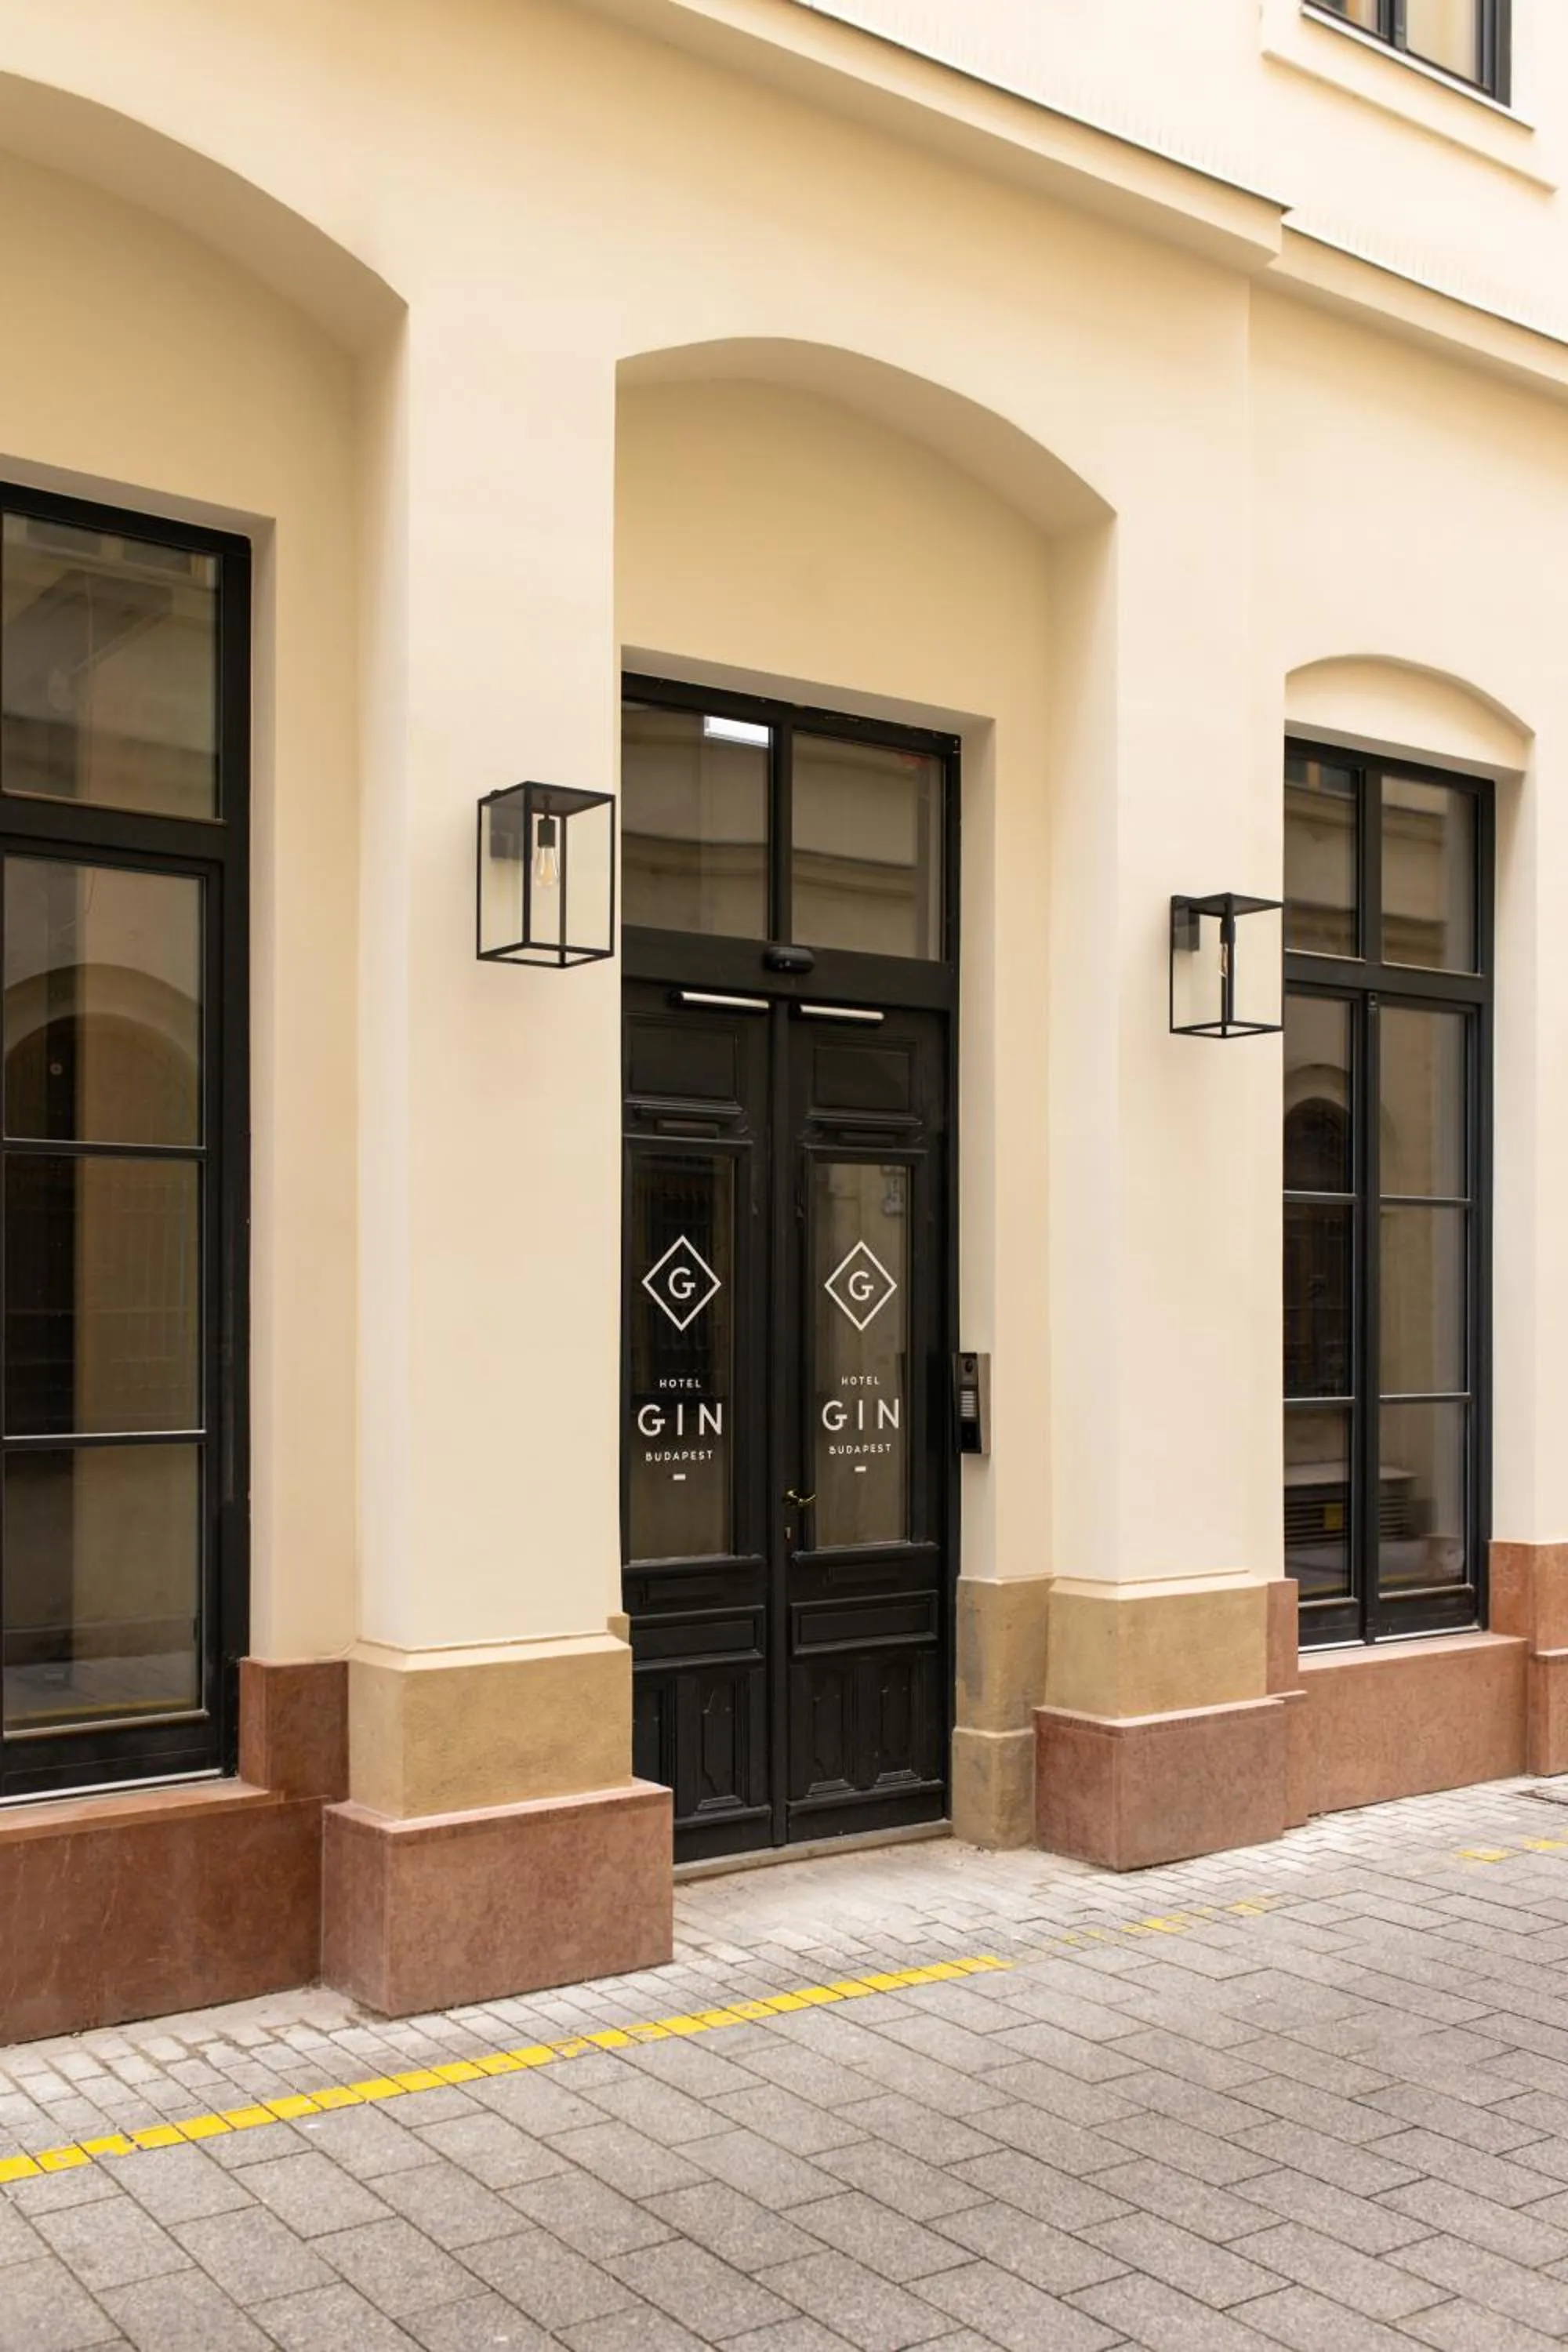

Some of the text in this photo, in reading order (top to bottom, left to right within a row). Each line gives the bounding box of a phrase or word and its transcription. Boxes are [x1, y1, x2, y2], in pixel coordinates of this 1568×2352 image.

[668, 1266, 696, 1299] G
[848, 1270, 874, 1301] G
[659, 1377, 702, 1388] HOTEL
[841, 1375, 880, 1385] HOTEL
[637, 1403, 722, 1437] GIN
[822, 1398, 899, 1431] GIN
[645, 1450, 713, 1461] BUDAPEST
[829, 1443, 892, 1454] BUDAPEST
